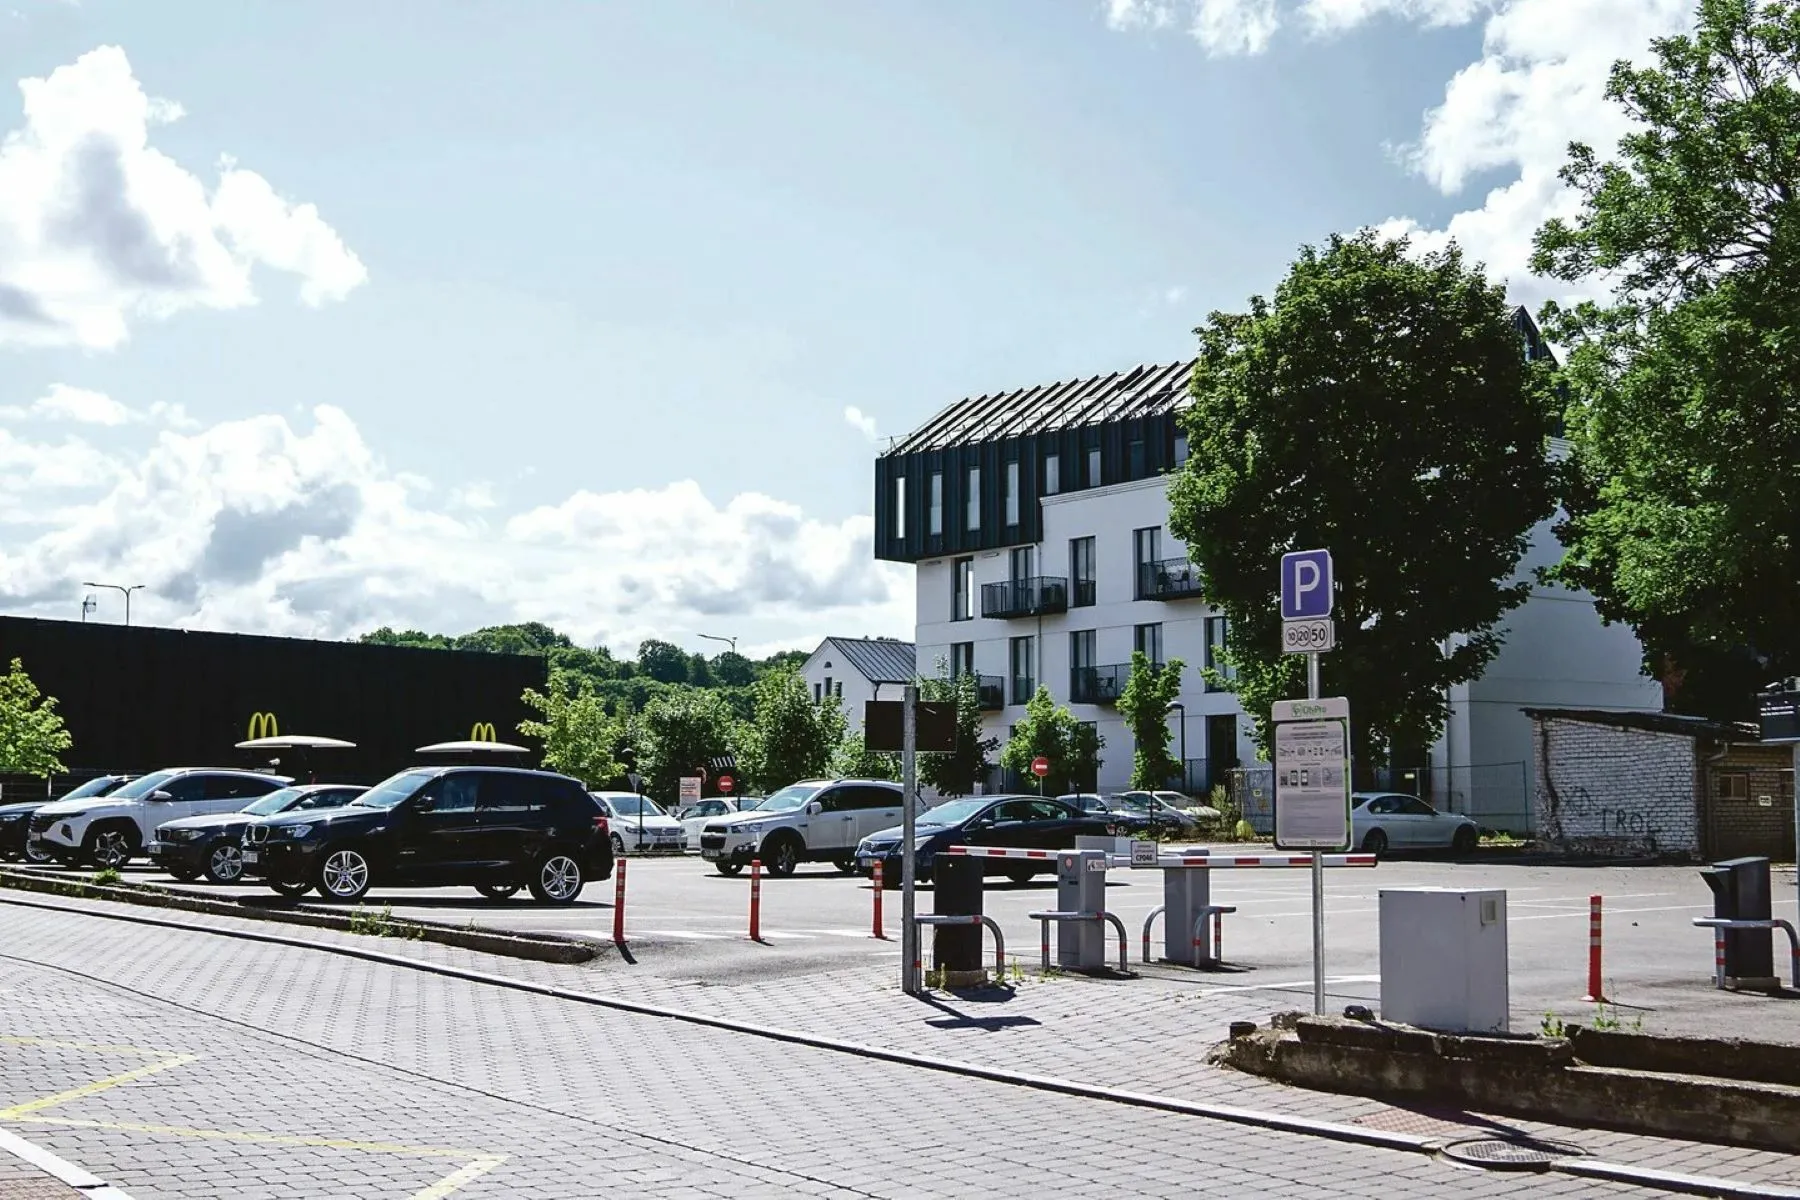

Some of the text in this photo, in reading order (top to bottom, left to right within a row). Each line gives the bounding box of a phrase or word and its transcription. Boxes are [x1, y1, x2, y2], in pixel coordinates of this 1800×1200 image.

[1295, 560, 1320, 611] P
[1299, 631, 1309, 641] 20
[1311, 628, 1325, 641] 50
